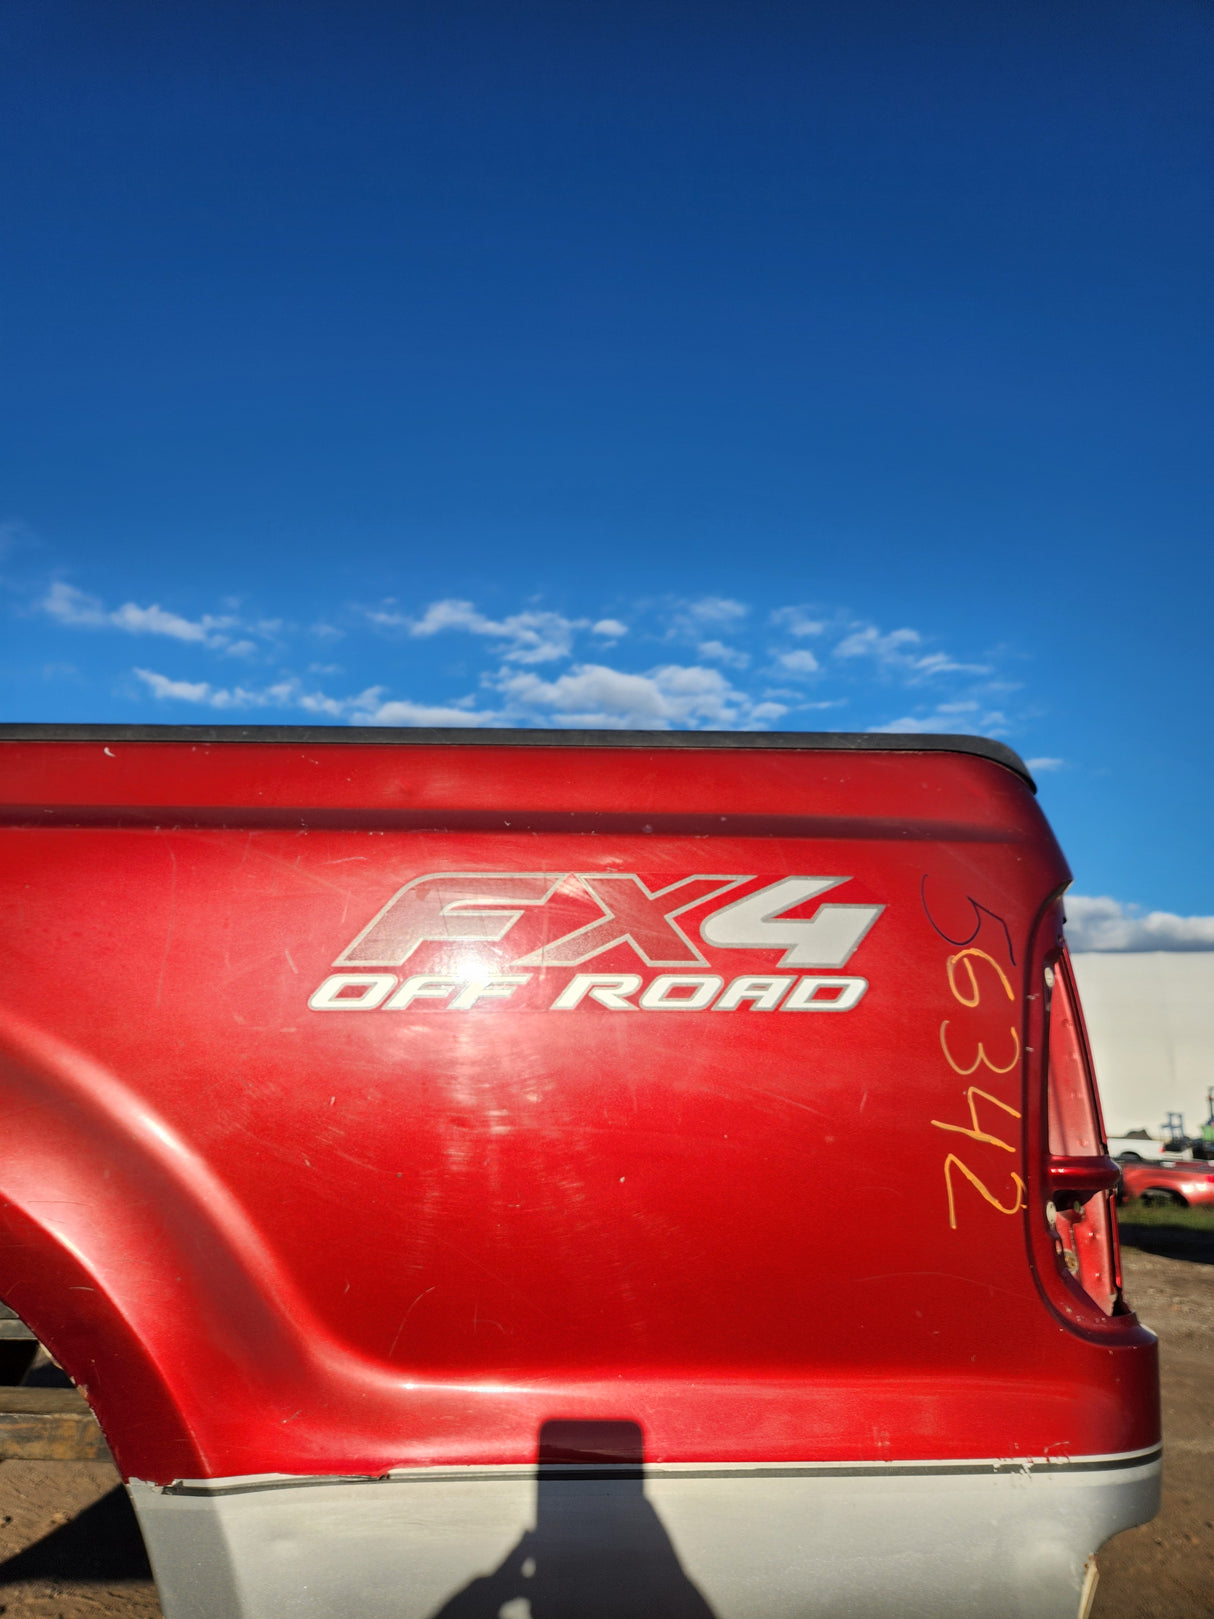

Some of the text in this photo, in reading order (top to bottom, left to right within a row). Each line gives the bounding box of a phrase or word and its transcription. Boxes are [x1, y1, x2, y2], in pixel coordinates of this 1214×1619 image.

[332, 872, 887, 968] FX4
[309, 973, 869, 1012] OFF ROAD
[922, 874, 1027, 1230] 56342
